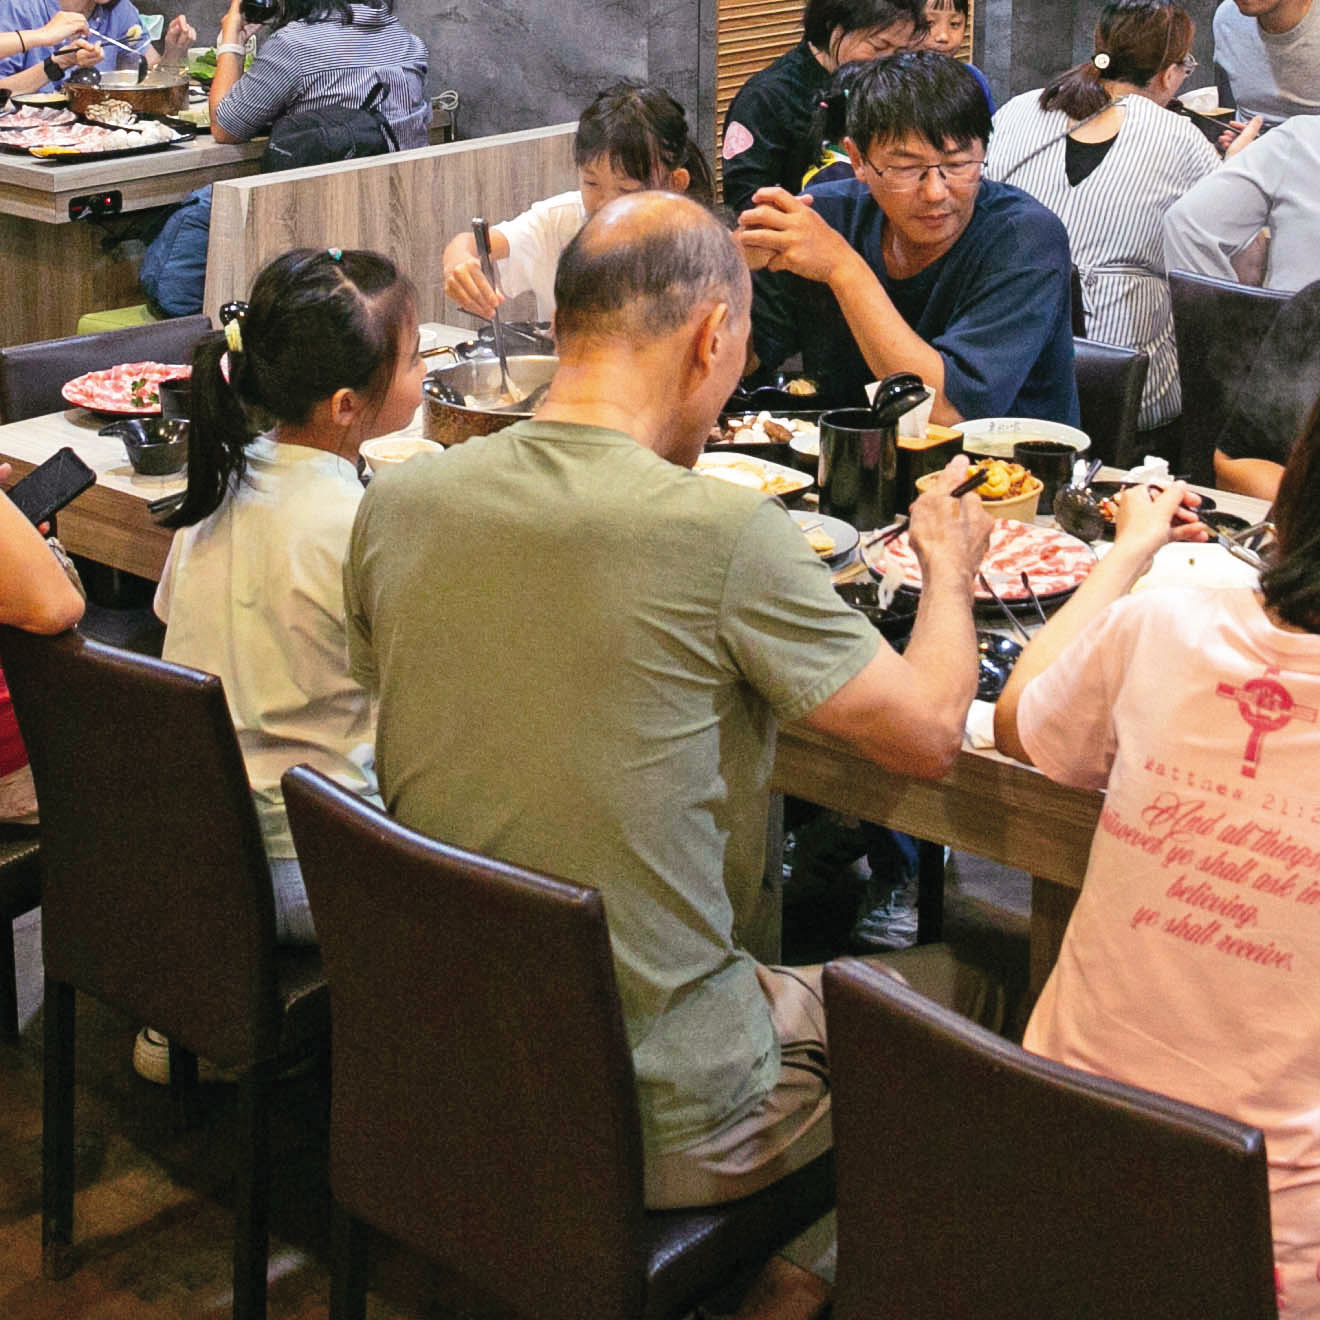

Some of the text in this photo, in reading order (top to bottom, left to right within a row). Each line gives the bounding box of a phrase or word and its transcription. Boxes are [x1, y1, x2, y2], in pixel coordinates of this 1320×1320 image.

[1141, 792, 1227, 843] And
[1217, 821, 1255, 846] all
[1195, 849, 1259, 883] shall
[1162, 913, 1223, 945] shall
